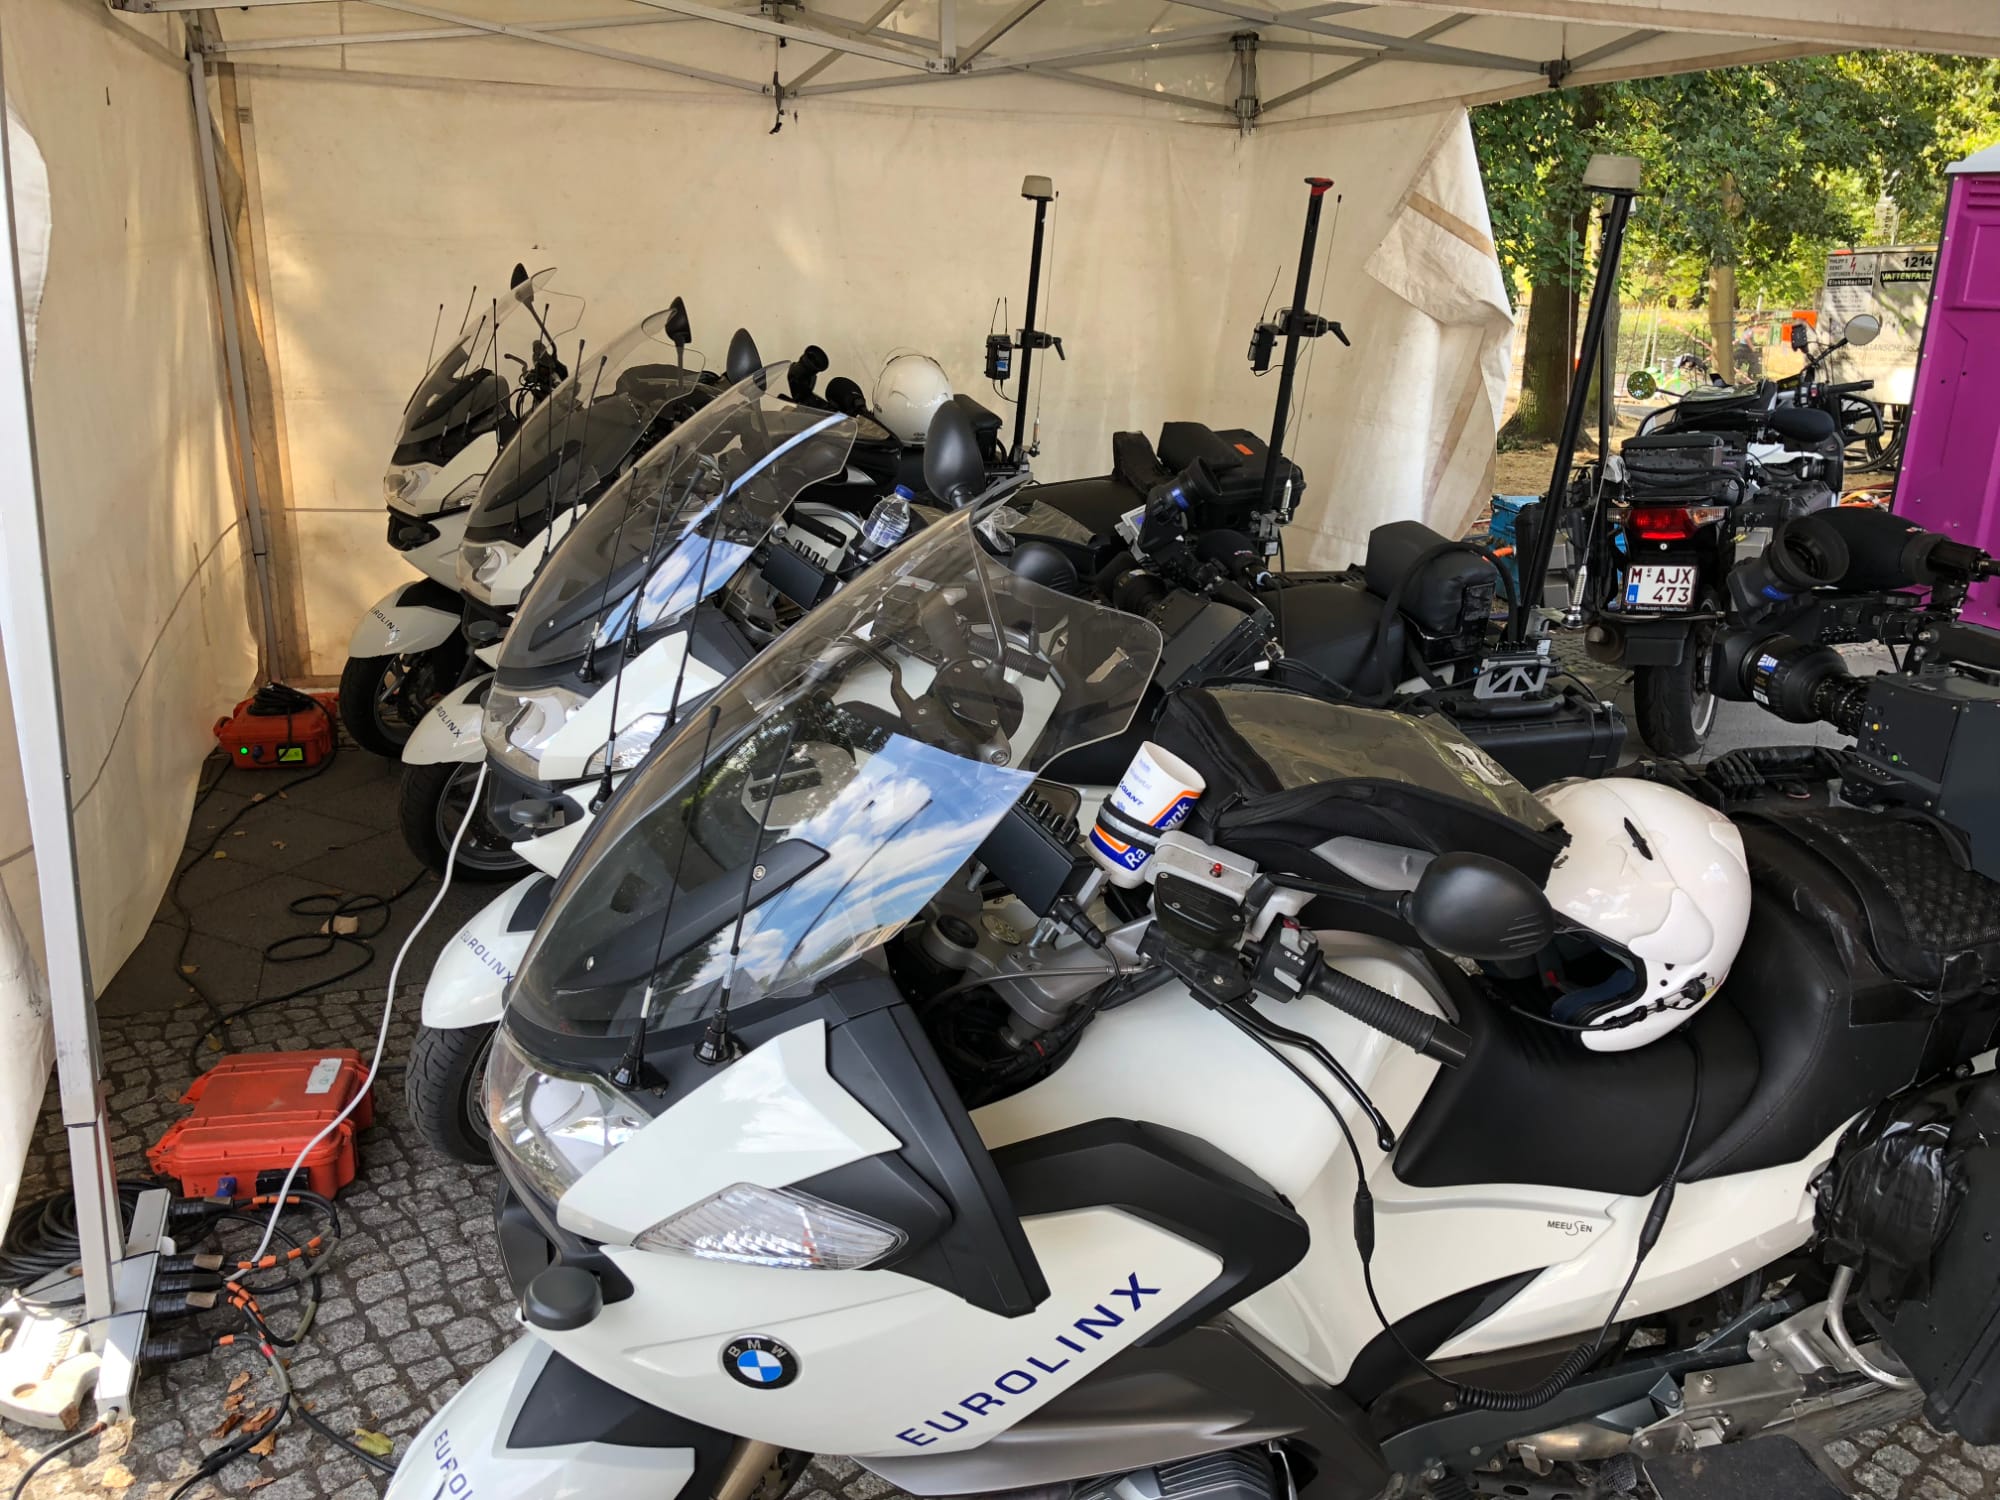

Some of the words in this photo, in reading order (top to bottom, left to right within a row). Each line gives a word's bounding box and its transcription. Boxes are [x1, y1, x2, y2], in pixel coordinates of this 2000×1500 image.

[1903, 256, 1933, 268] 1214
[1653, 587, 1690, 603] 473
[1547, 1220, 1593, 1237] MEEUSEN
[728, 1339, 787, 1358] BMW
[895, 1272, 1161, 1446] EUROLINX
